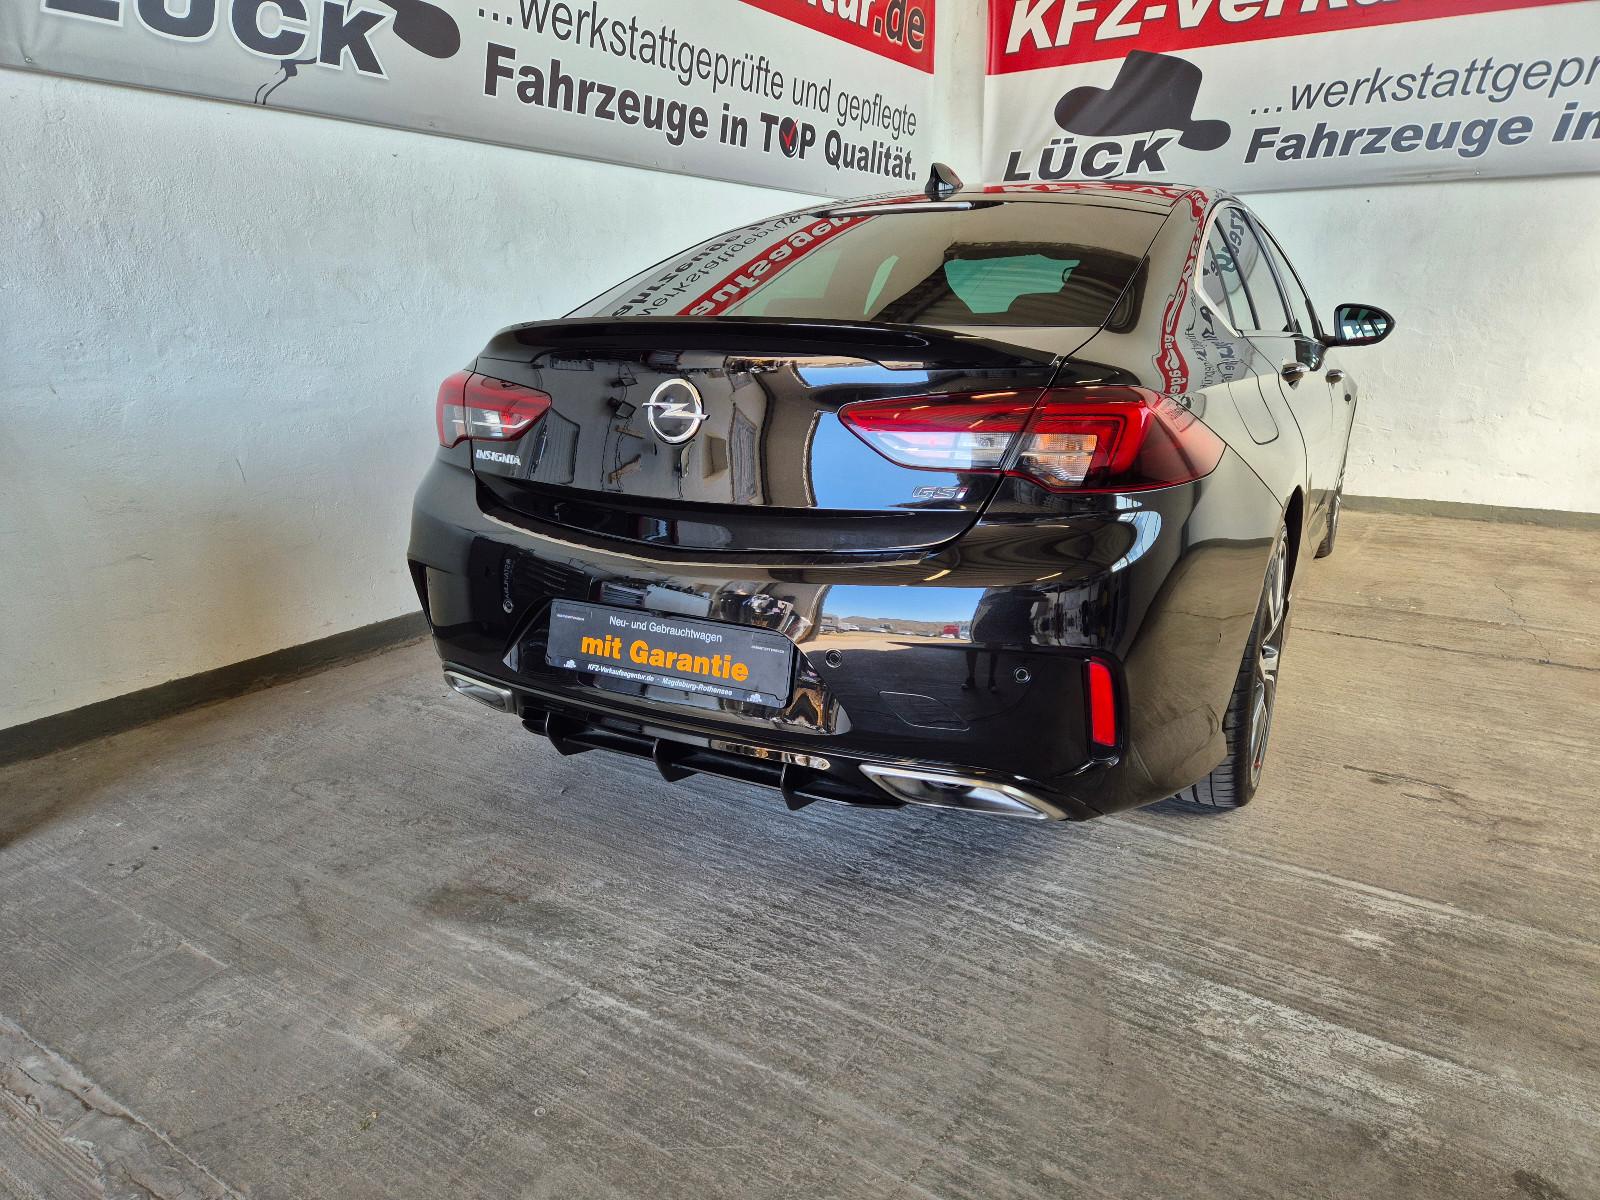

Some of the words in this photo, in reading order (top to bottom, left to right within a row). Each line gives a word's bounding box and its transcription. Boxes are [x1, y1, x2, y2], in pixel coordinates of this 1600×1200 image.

[42, 0, 386, 78] CK
[478, 0, 784, 100] ...werkstattgeprüfte
[792, 77, 831, 114] und
[837, 91, 917, 141] gepflegte
[484, 41, 709, 147] Fahrzeuge
[719, 102, 748, 148] in
[824, 129, 916, 181] Qualität.
[1244, 114, 1534, 164] Fahrzeuge
[1552, 101, 1600, 142] in
[1003, 134, 1176, 182] LÜCK
[475, 448, 521, 466] INSIGNIA
[609, 615, 629, 628] Neu-
[631, 619, 647, 631] und
[649, 622, 722, 643] Gebrauchtwagen
[581, 634, 622, 659] mit
[630, 640, 749, 682] Garantie
